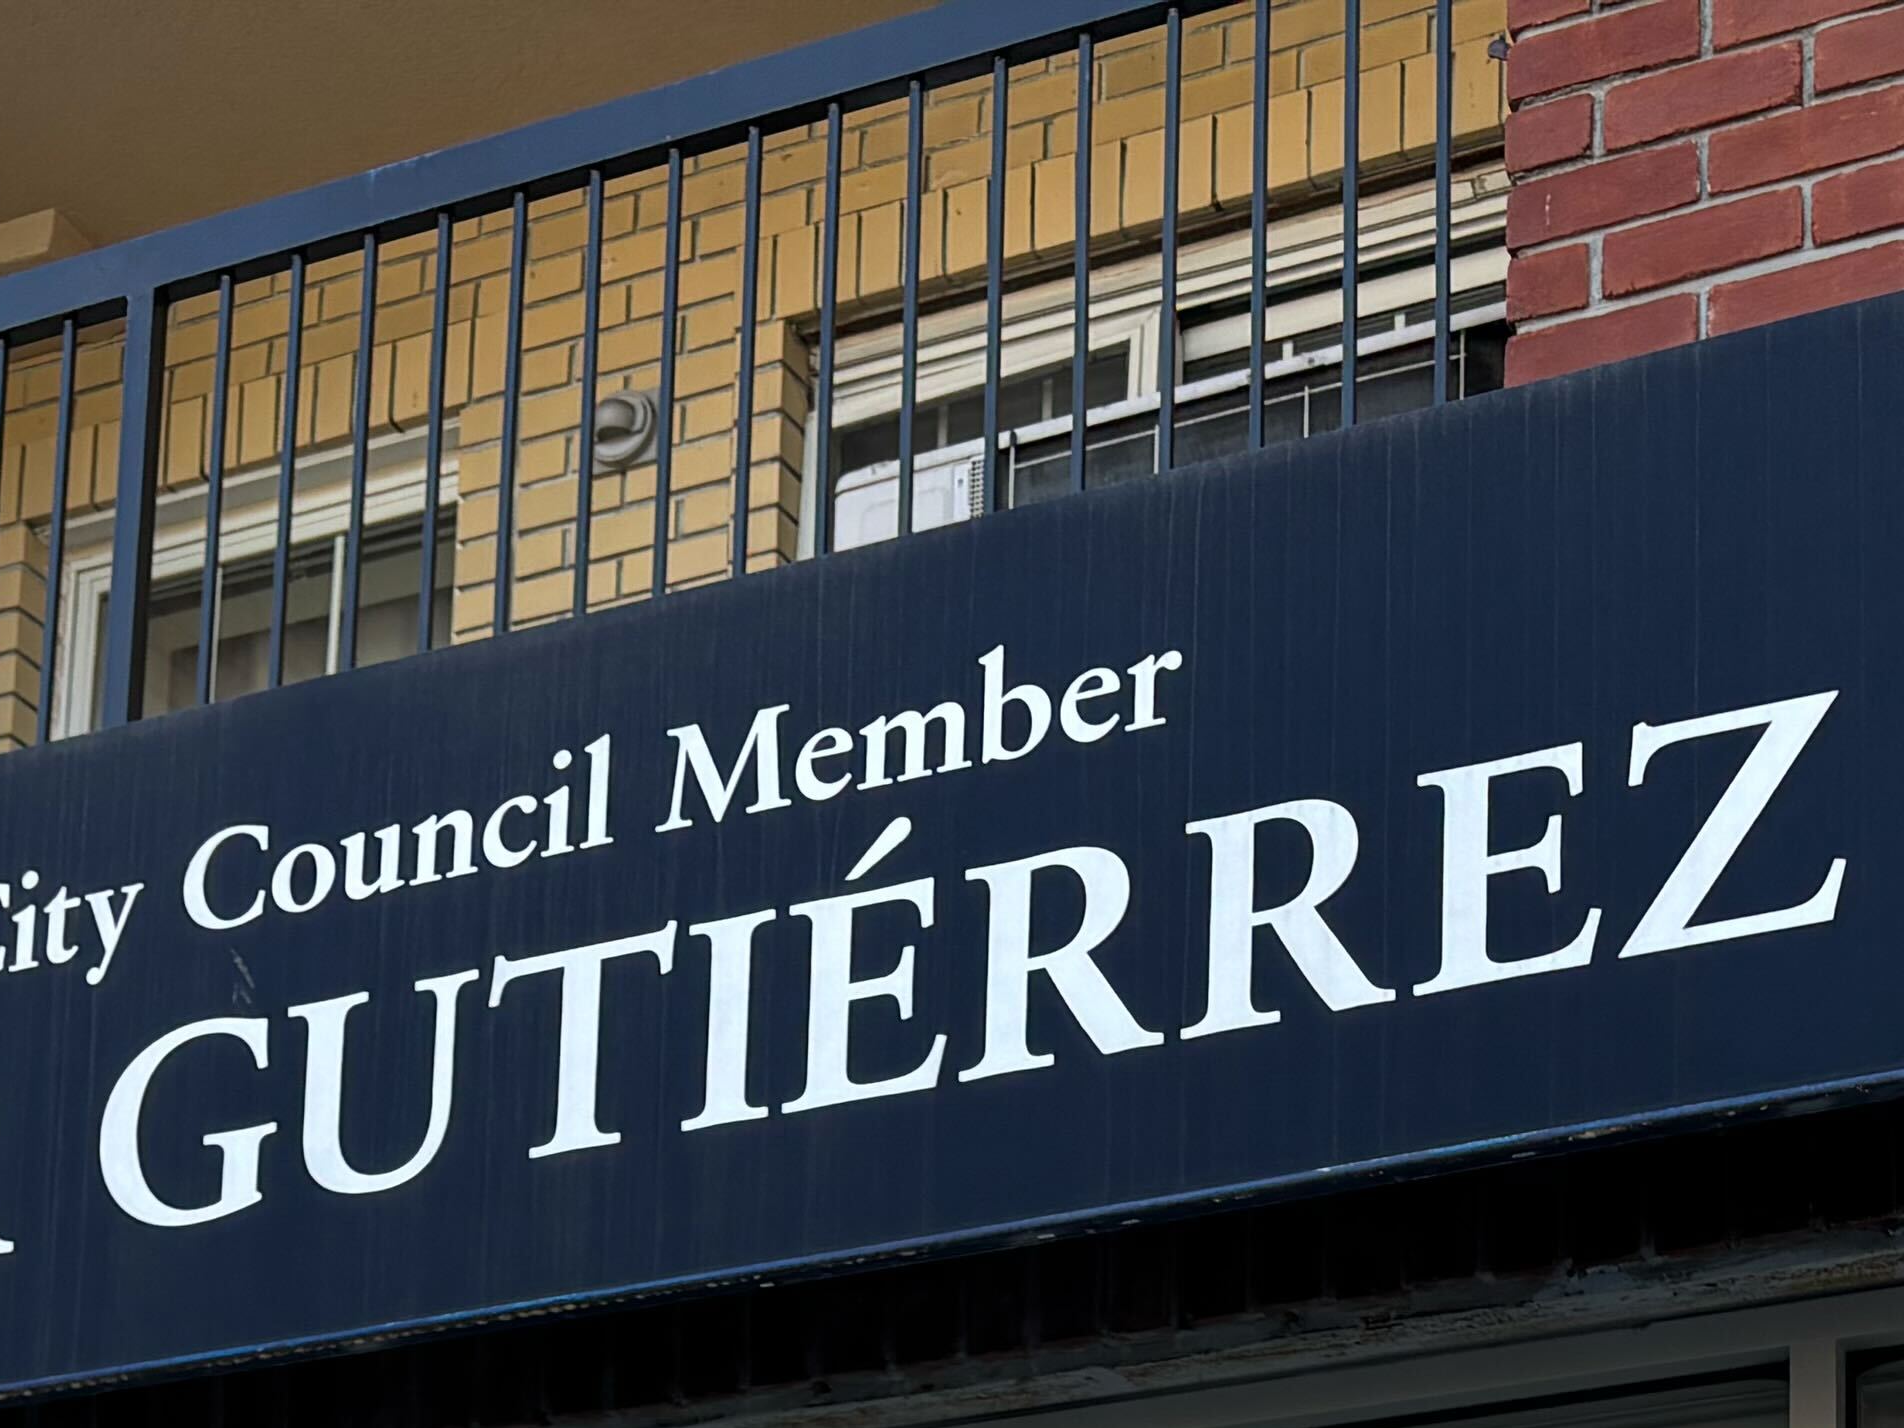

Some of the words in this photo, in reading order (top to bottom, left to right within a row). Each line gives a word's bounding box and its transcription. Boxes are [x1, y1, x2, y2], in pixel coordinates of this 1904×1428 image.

[100, 691, 1846, 1226] GUTIÉRREZ
[184, 734, 613, 929] Council
[655, 645, 1182, 832] Member
